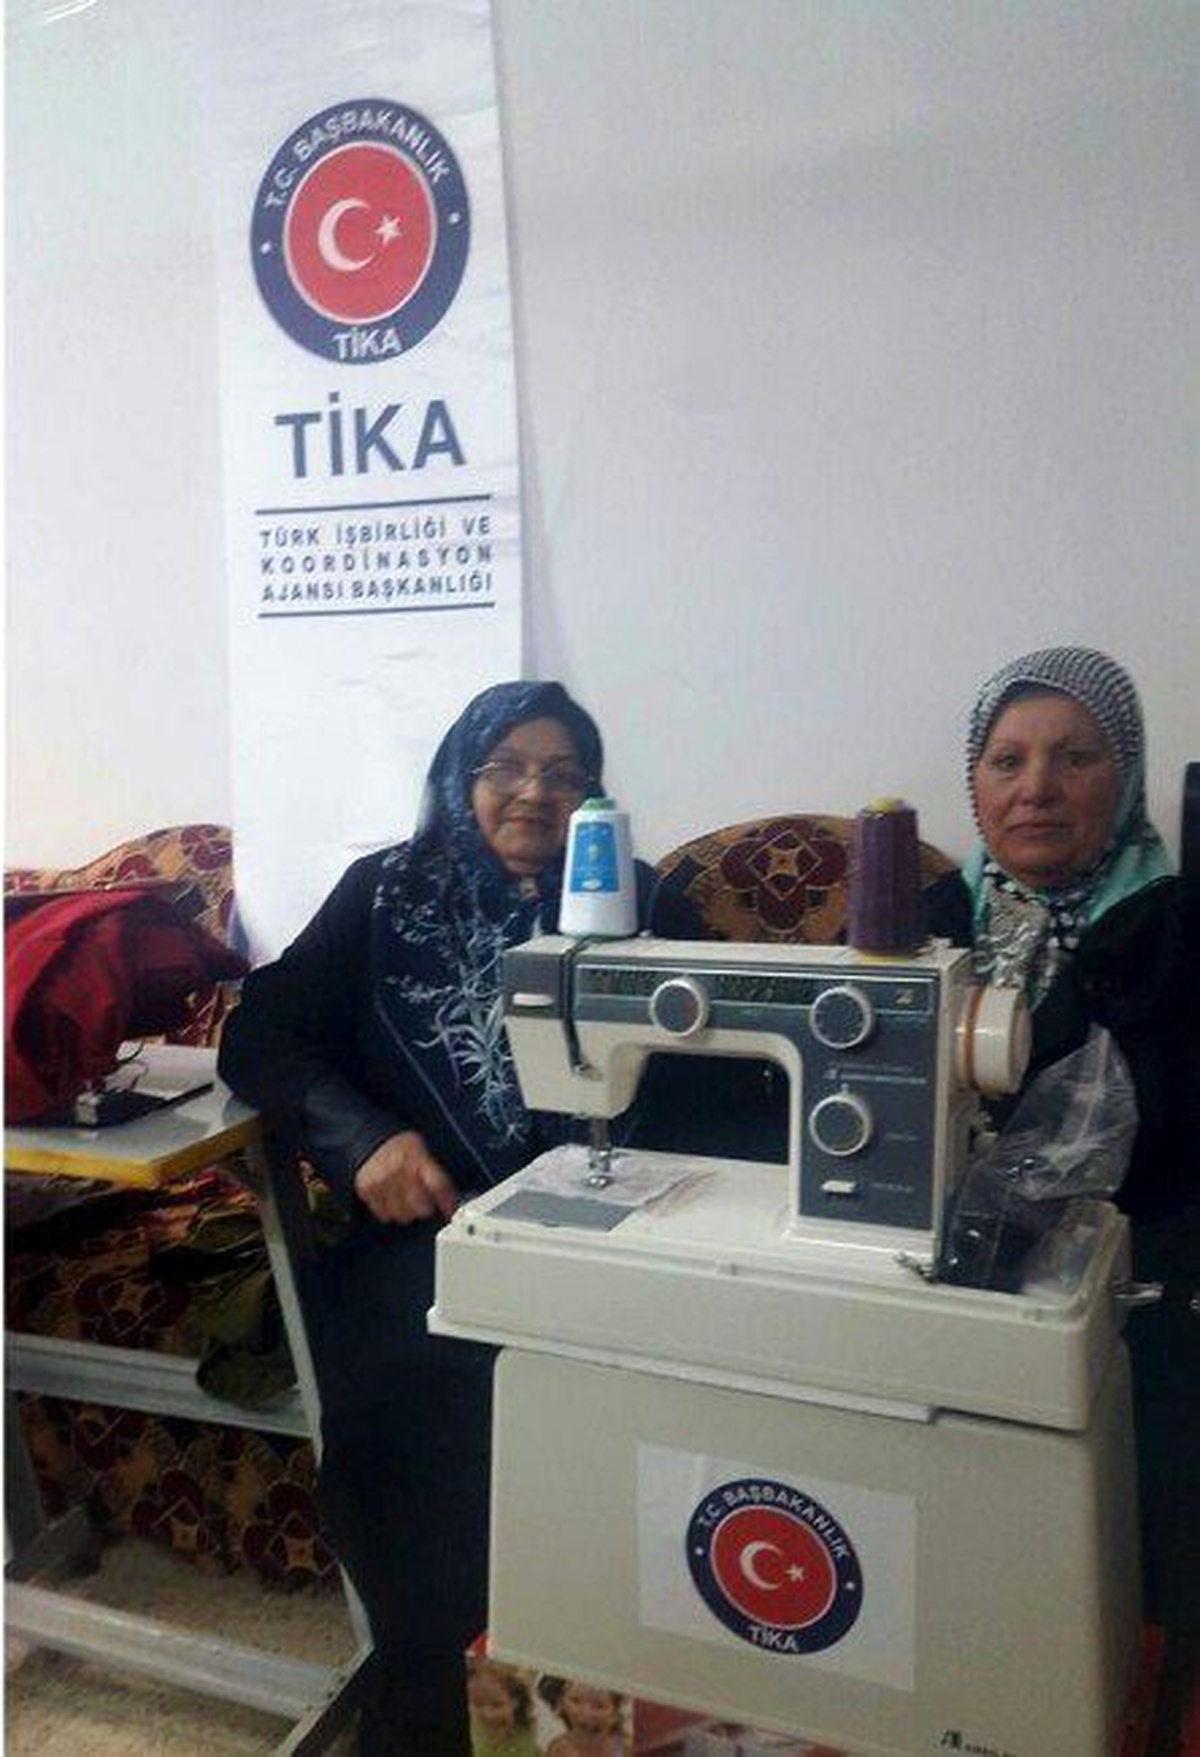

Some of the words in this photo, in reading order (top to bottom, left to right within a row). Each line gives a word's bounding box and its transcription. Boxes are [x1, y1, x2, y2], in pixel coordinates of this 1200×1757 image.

[294, 109, 450, 183] BAŞBAKANLIK
[332, 325, 403, 361] TİKA
[274, 391, 467, 479] TİKA
[259, 526, 321, 549] TÜRK
[336, 514, 447, 549] İŞBİRLİĞİ
[462, 515, 491, 537] VE
[260, 545, 493, 576] KOORDİNASYON
[262, 581, 344, 603] AJANSI
[351, 570, 493, 604] BAŞKANLIĞI
[722, 1485, 852, 1560] BAŞBAKANLIK
[746, 1624, 801, 1652] TİKA
